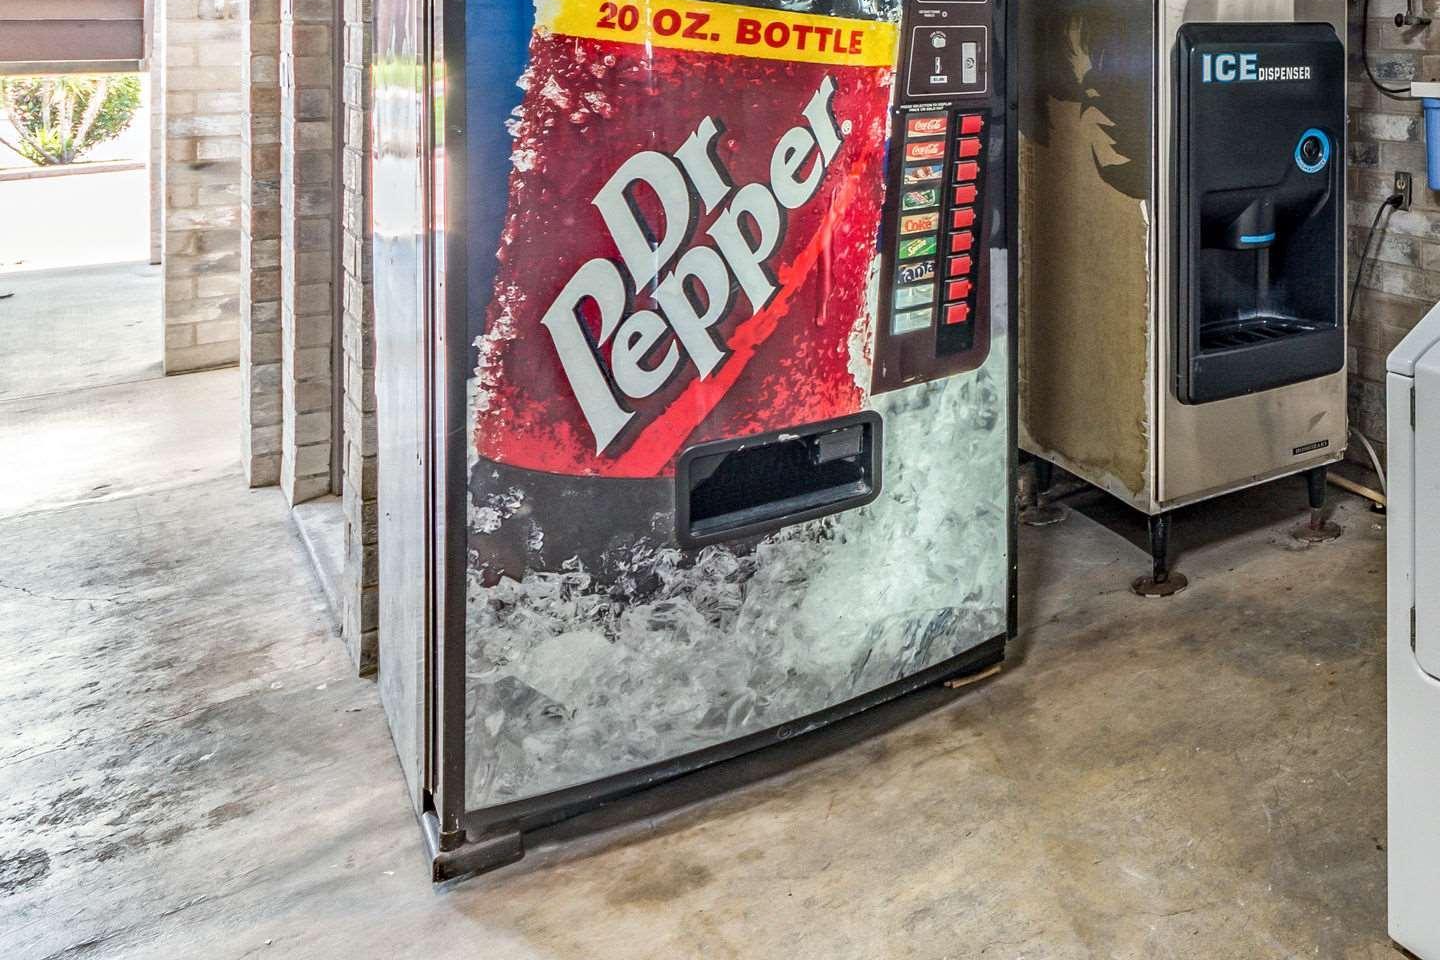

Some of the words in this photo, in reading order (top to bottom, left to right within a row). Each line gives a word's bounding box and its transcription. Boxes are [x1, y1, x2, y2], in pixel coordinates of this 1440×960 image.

[596, 1, 639, 33] 20
[651, 8, 720, 41] OZ.
[735, 18, 864, 55] BOTTLE
[1202, 53, 1258, 83] ICE
[1258, 66, 1311, 81] DISPENSER
[591, 116, 732, 296] Dr
[904, 219, 932, 233] Coke
[541, 75, 845, 456] Pepper
